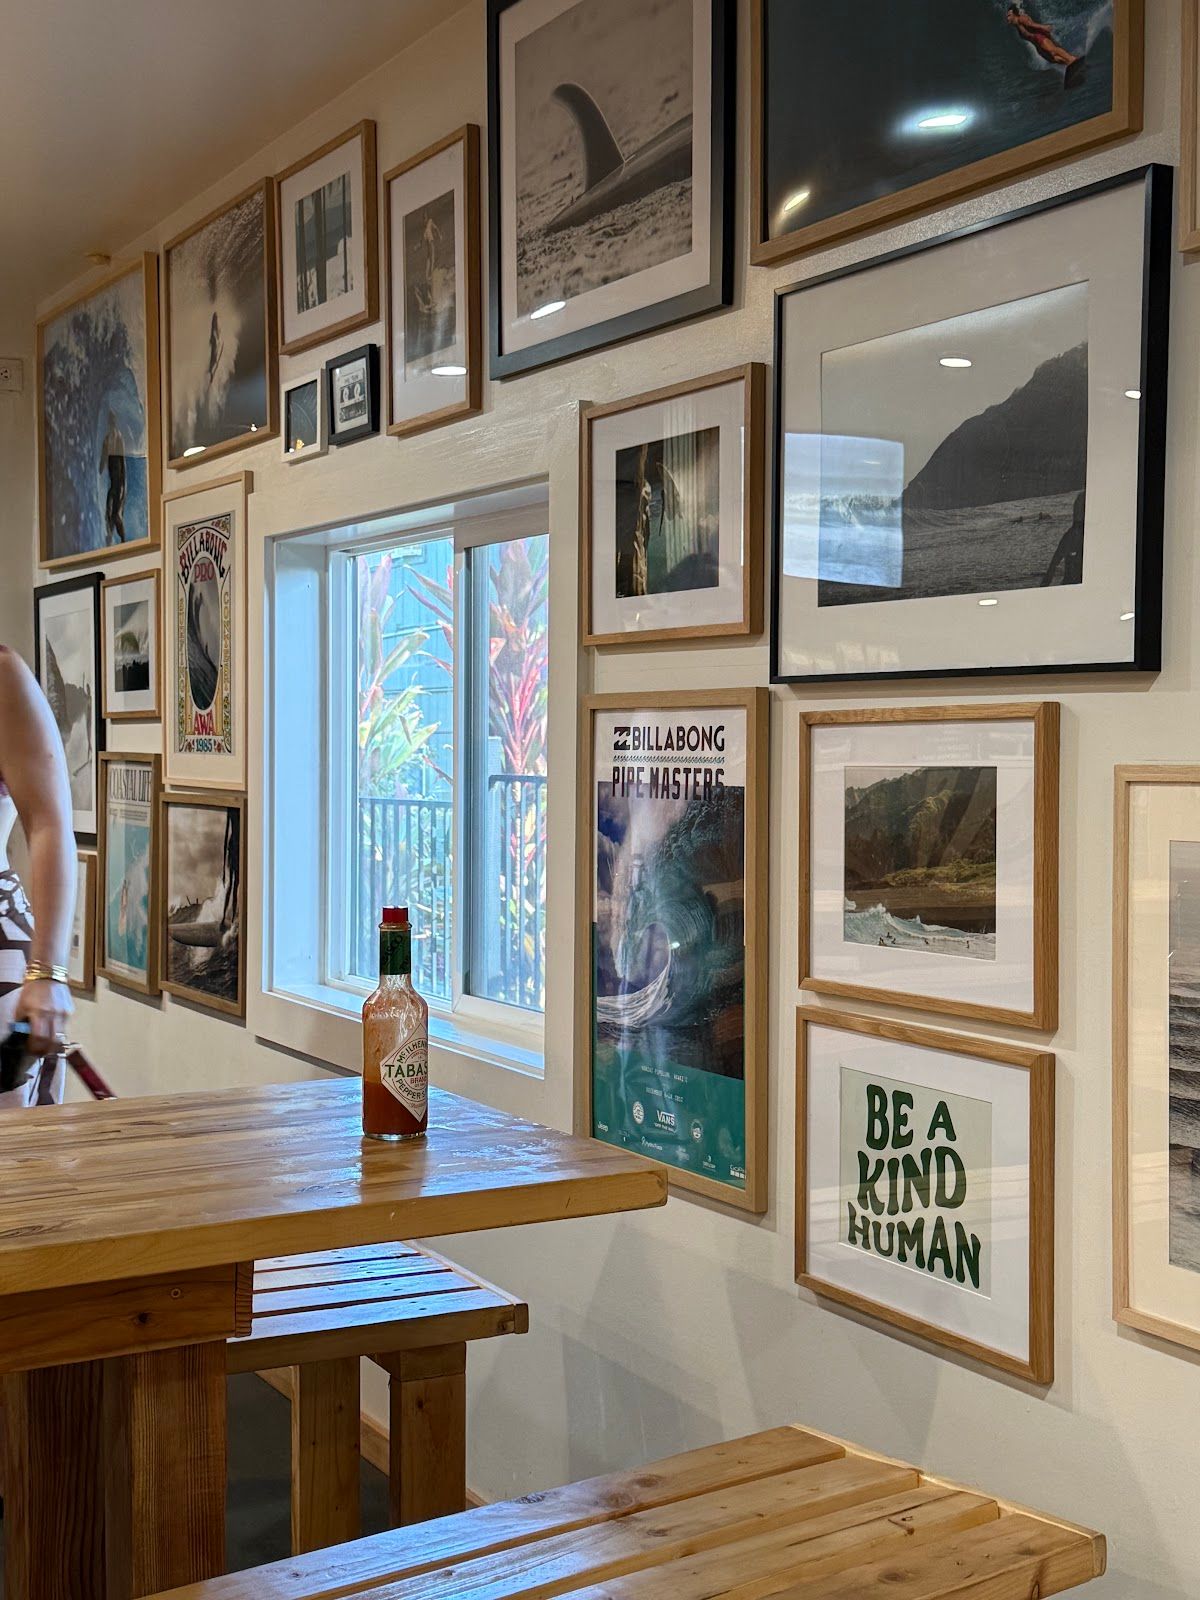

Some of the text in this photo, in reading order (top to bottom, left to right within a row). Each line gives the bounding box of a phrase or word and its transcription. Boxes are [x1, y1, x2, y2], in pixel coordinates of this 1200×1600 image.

[180, 530, 228, 584] BILLABONG
[194, 561, 216, 583] PRO
[194, 708, 215, 736] AWA
[195, 738, 213, 752] 1985
[632, 725, 725, 752] BILLABONG
[612, 766, 725, 801] PIPE MASTERS
[656, 1109, 676, 1126] VANS
[866, 1083, 957, 1151] BE A
[857, 1145, 967, 1216] KIND
[847, 1201, 981, 1289] HUMAN
